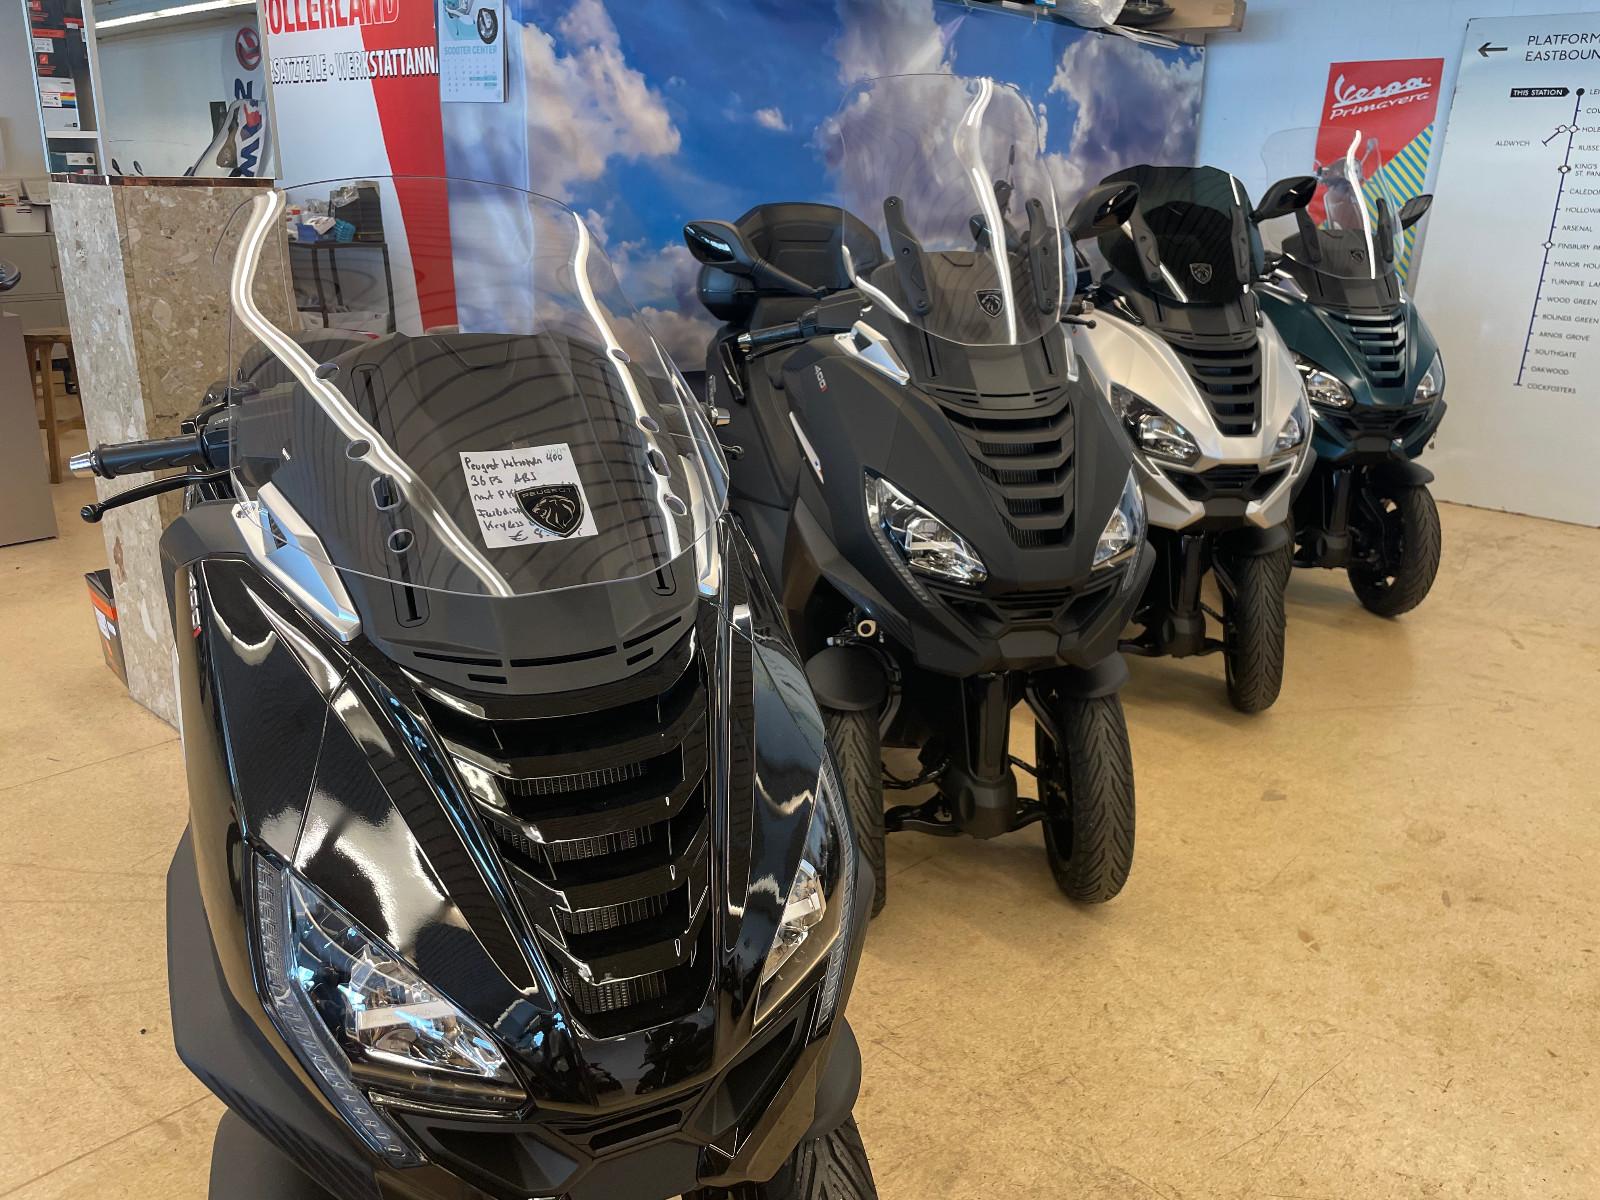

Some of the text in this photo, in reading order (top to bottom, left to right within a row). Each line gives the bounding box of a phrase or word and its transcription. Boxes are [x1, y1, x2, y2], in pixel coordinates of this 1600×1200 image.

[263, 0, 399, 35] OLLERLAND
[271, 54, 327, 84] SATZTEILE
[1332, 74, 1432, 108] Vespa
[1495, 139, 1530, 147] ALDWYCH
[1546, 296, 1598, 306] WOOD GREEN
[1574, 316, 1599, 324] GREEN
[1565, 333, 1591, 341] GROVE
[1535, 348, 1577, 358] SOUTHGATE
[1531, 366, 1569, 375] OAKWOOD
[1527, 382, 1576, 394] COCKFOSTERS
[546, 453, 563, 463] 400
[471, 474, 486, 486] 36
[522, 487, 572, 498] PEUGEOT
